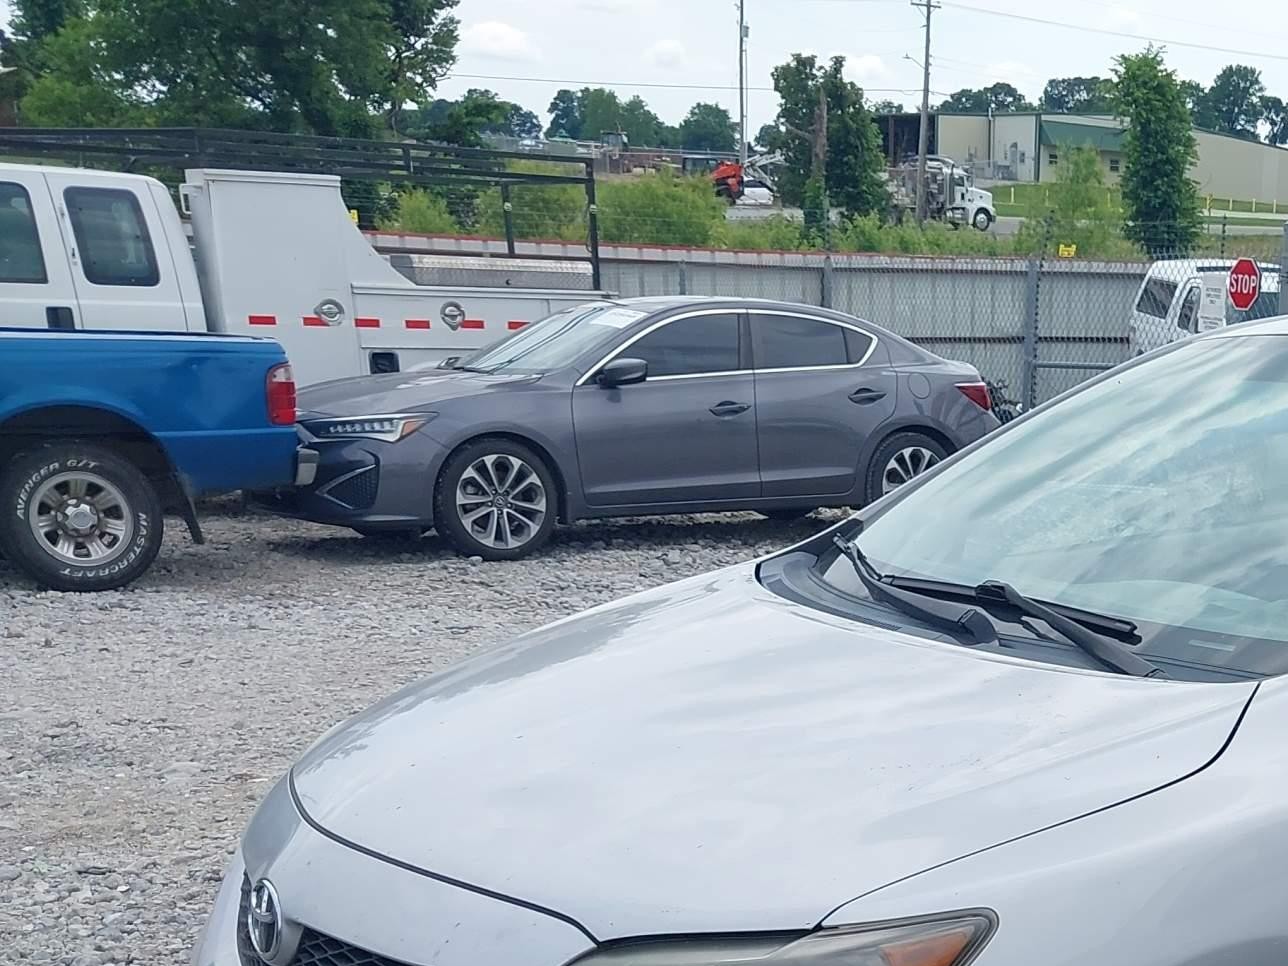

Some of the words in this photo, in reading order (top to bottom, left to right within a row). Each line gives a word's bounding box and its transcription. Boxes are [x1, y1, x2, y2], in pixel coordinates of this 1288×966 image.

[1230, 274, 1257, 294] STOP
[16, 462, 60, 520] AVENGER
[66, 459, 98, 469] G/T
[60, 512, 149, 577] MASTERCRAFT
